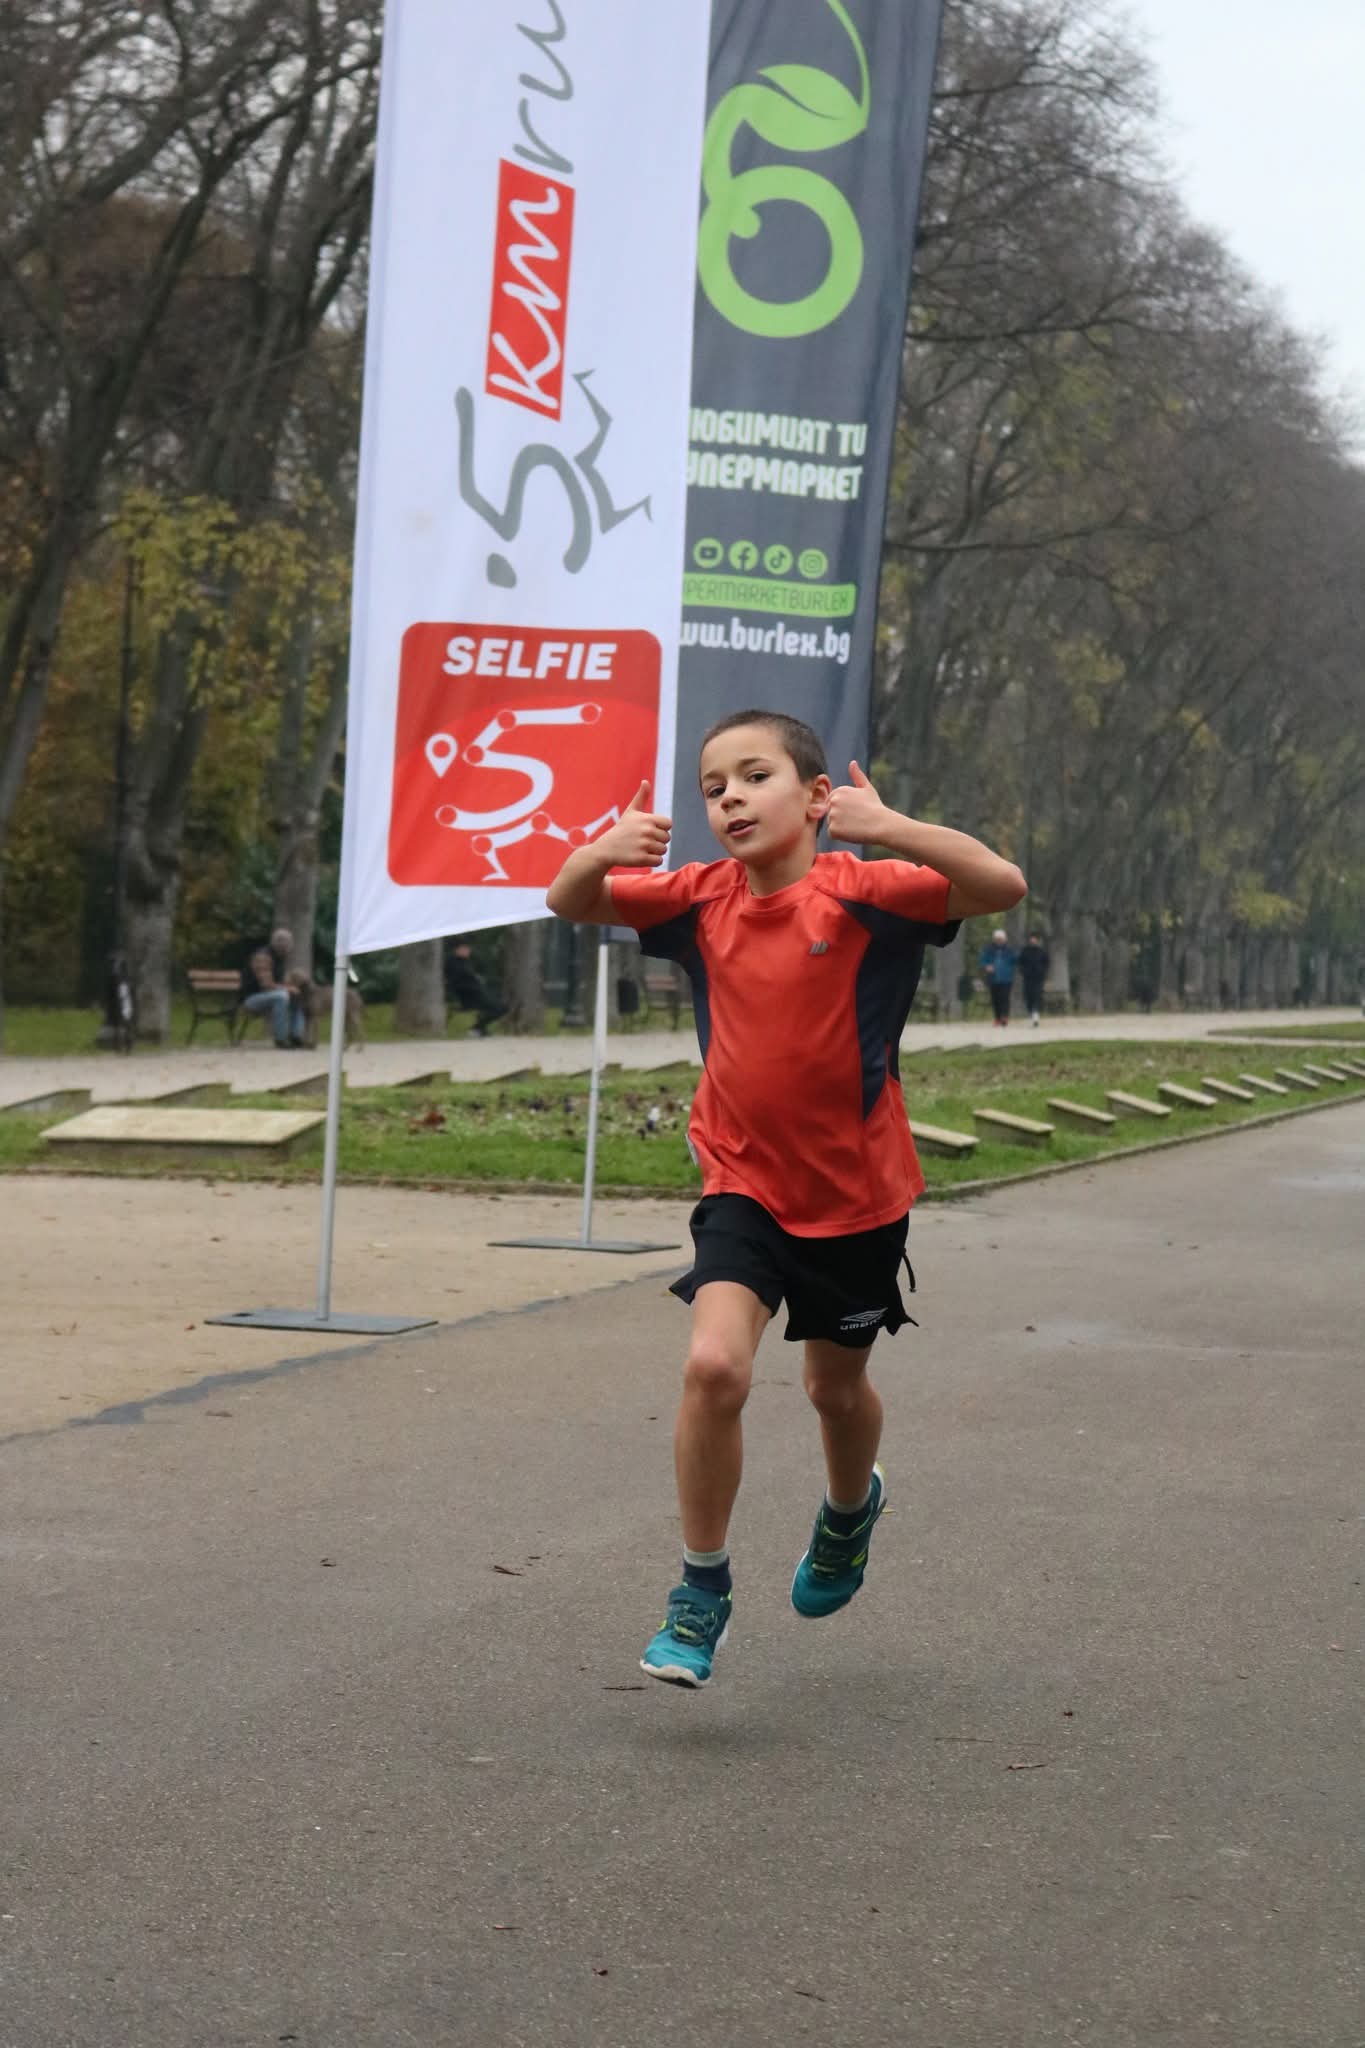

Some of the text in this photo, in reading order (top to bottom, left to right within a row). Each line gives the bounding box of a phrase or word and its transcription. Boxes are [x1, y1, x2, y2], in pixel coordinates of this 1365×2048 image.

[687, 407, 832, 455] ЮБИМИЯТ
[685, 578, 850, 612] PERMARKETBURLEX
[442, 635, 618, 681] SELFIE
